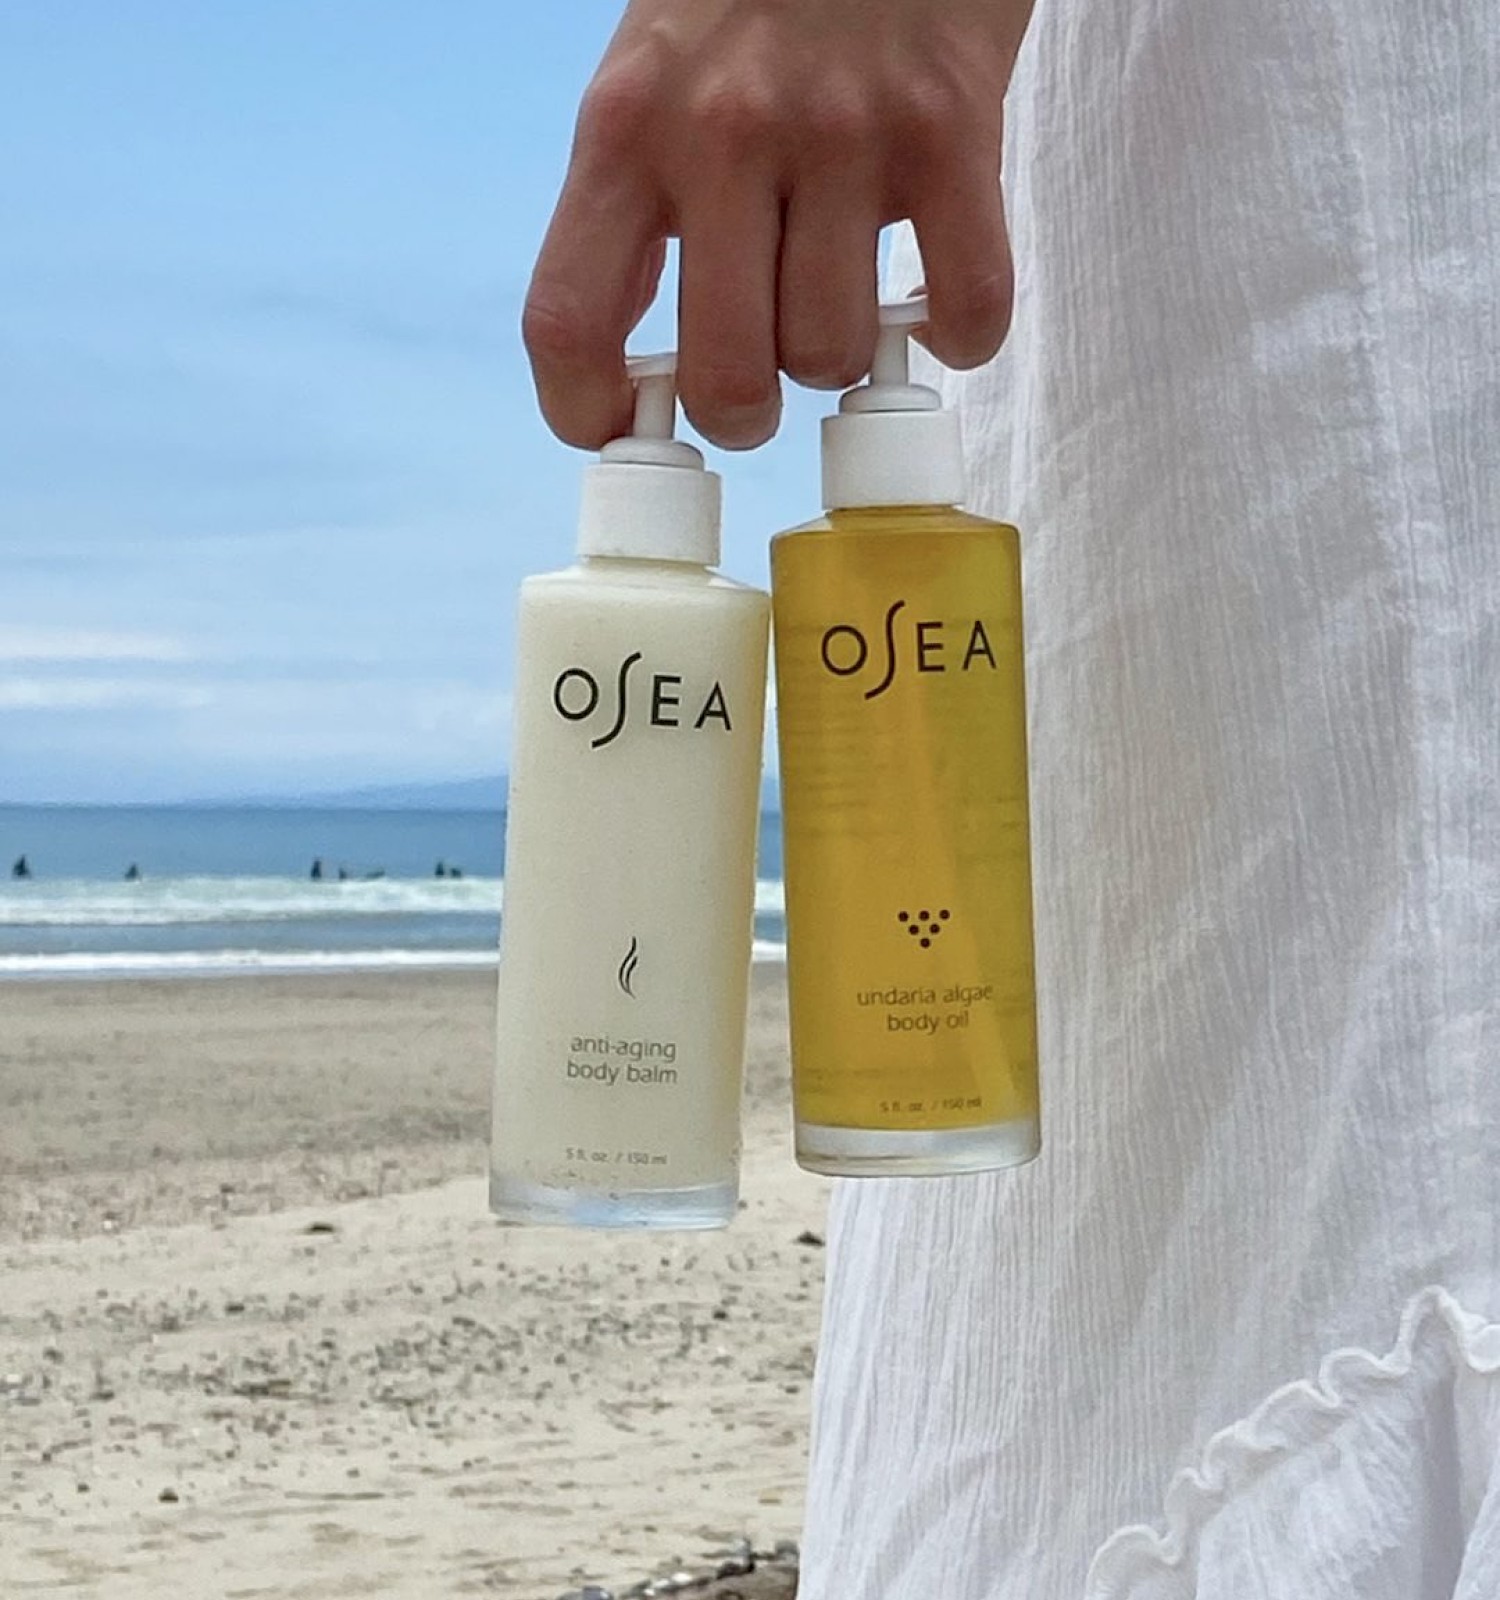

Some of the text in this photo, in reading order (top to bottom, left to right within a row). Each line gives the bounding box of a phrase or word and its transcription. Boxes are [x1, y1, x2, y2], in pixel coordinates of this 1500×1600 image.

[820, 600, 996, 700] OSEA
[554, 652, 732, 748] OSEA
[857, 984, 994, 1008] undaria algae
[887, 1010, 969, 1036] body oil
[571, 1035, 676, 1063] anti-aging
[566, 1060, 677, 1086] body balm
[566, 1149, 574, 1160] 5
